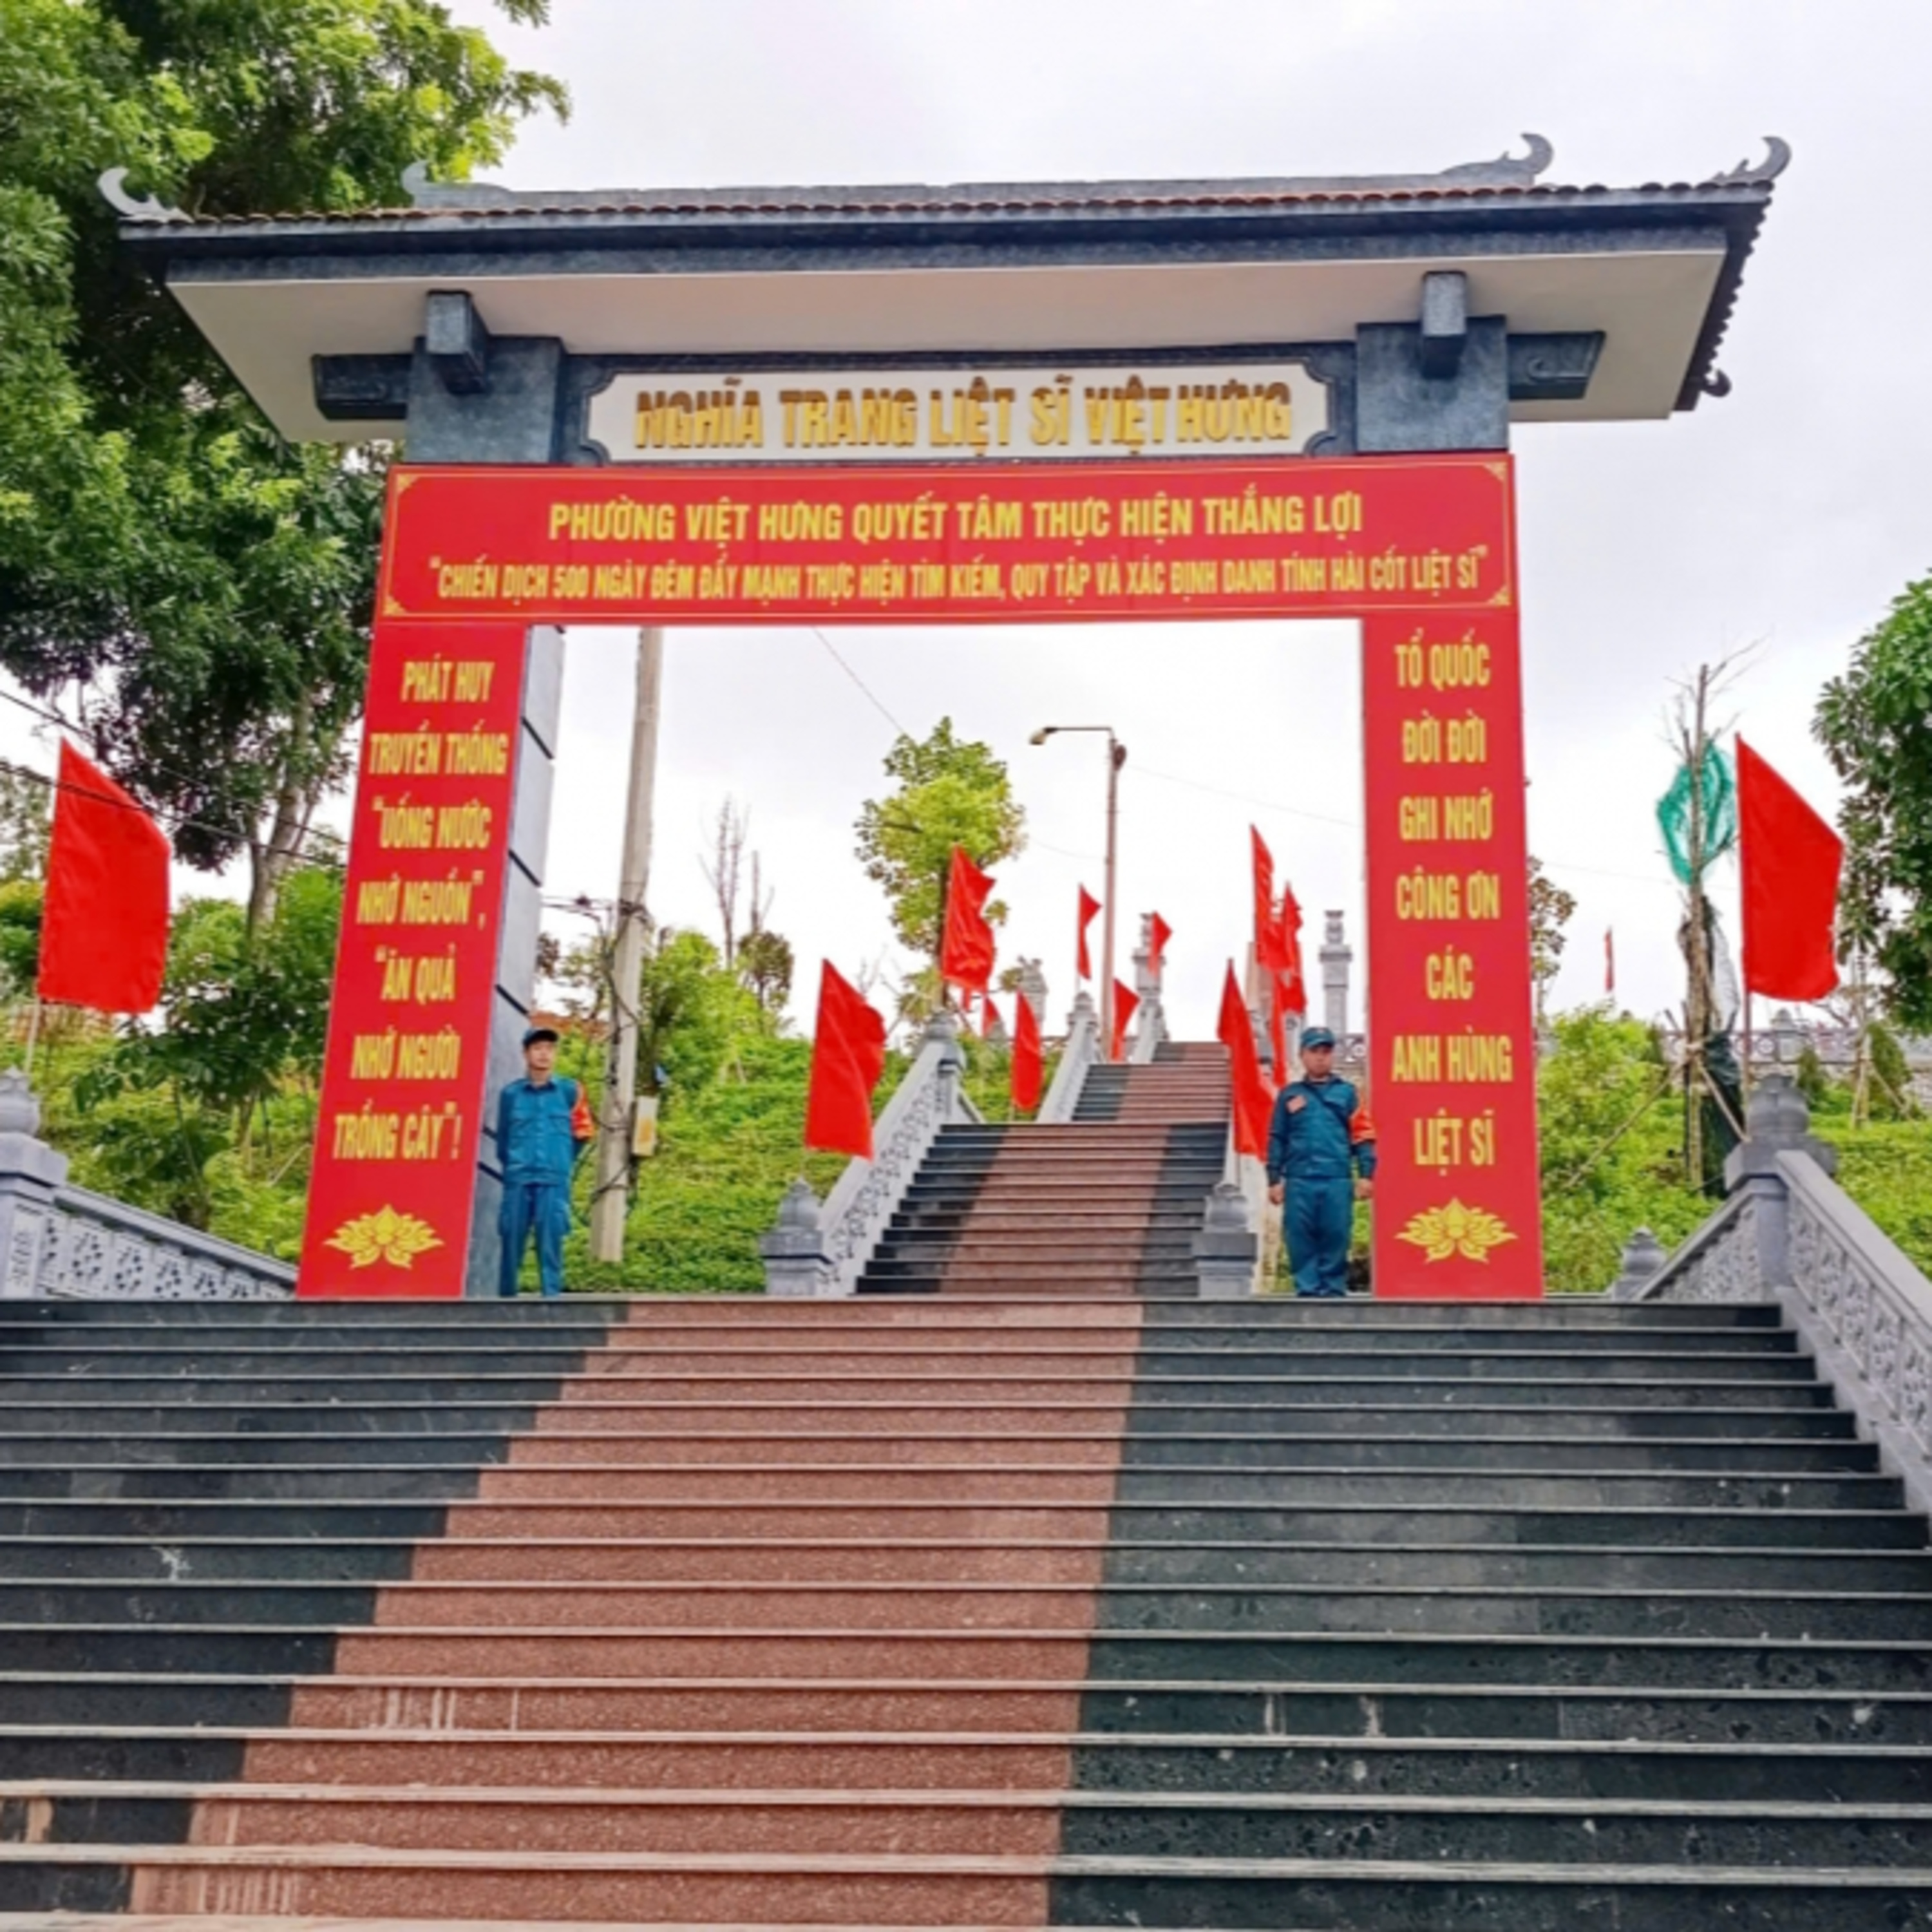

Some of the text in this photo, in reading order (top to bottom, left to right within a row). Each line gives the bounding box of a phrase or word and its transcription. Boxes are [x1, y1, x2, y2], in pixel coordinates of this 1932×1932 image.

[634, 374, 1292, 457] NGHĨA TRANG LIỆT SĨ VIỆT HƯNG
[549, 482, 1363, 549] PHƯỜNG VIỆT HƯNG QUYẾT TÂM THỰC HIỆN THẮNG LỢI
[500, 564, 549, 607] DỊCH
[552, 564, 589, 599] 500
[742, 564, 801, 607] MẠNH
[806, 562, 856, 607] THỰC
[859, 557, 905, 607] HIỆN
[1010, 563, 1050, 602] QUY
[1054, 555, 1091, 605] TẬP
[1095, 554, 1121, 596] VÀ
[1126, 553, 1166, 595] XÁC
[1222, 558, 1276, 594] DANH
[1411, 547, 1452, 598] LIỆT
[401, 652, 496, 702] PHÁT HUY
[1394, 627, 1490, 692] TỔ QUỐC
[444, 719, 510, 775] THỐNG
[1399, 786, 1493, 840] GHI NHỚ
[1396, 864, 1501, 920] CÔNG ƠN
[1425, 943, 1475, 1000] CÁC
[1391, 1023, 1513, 1083] ANH HÙNG
[1414, 1106, 1495, 1177] LIỆT SĨ
